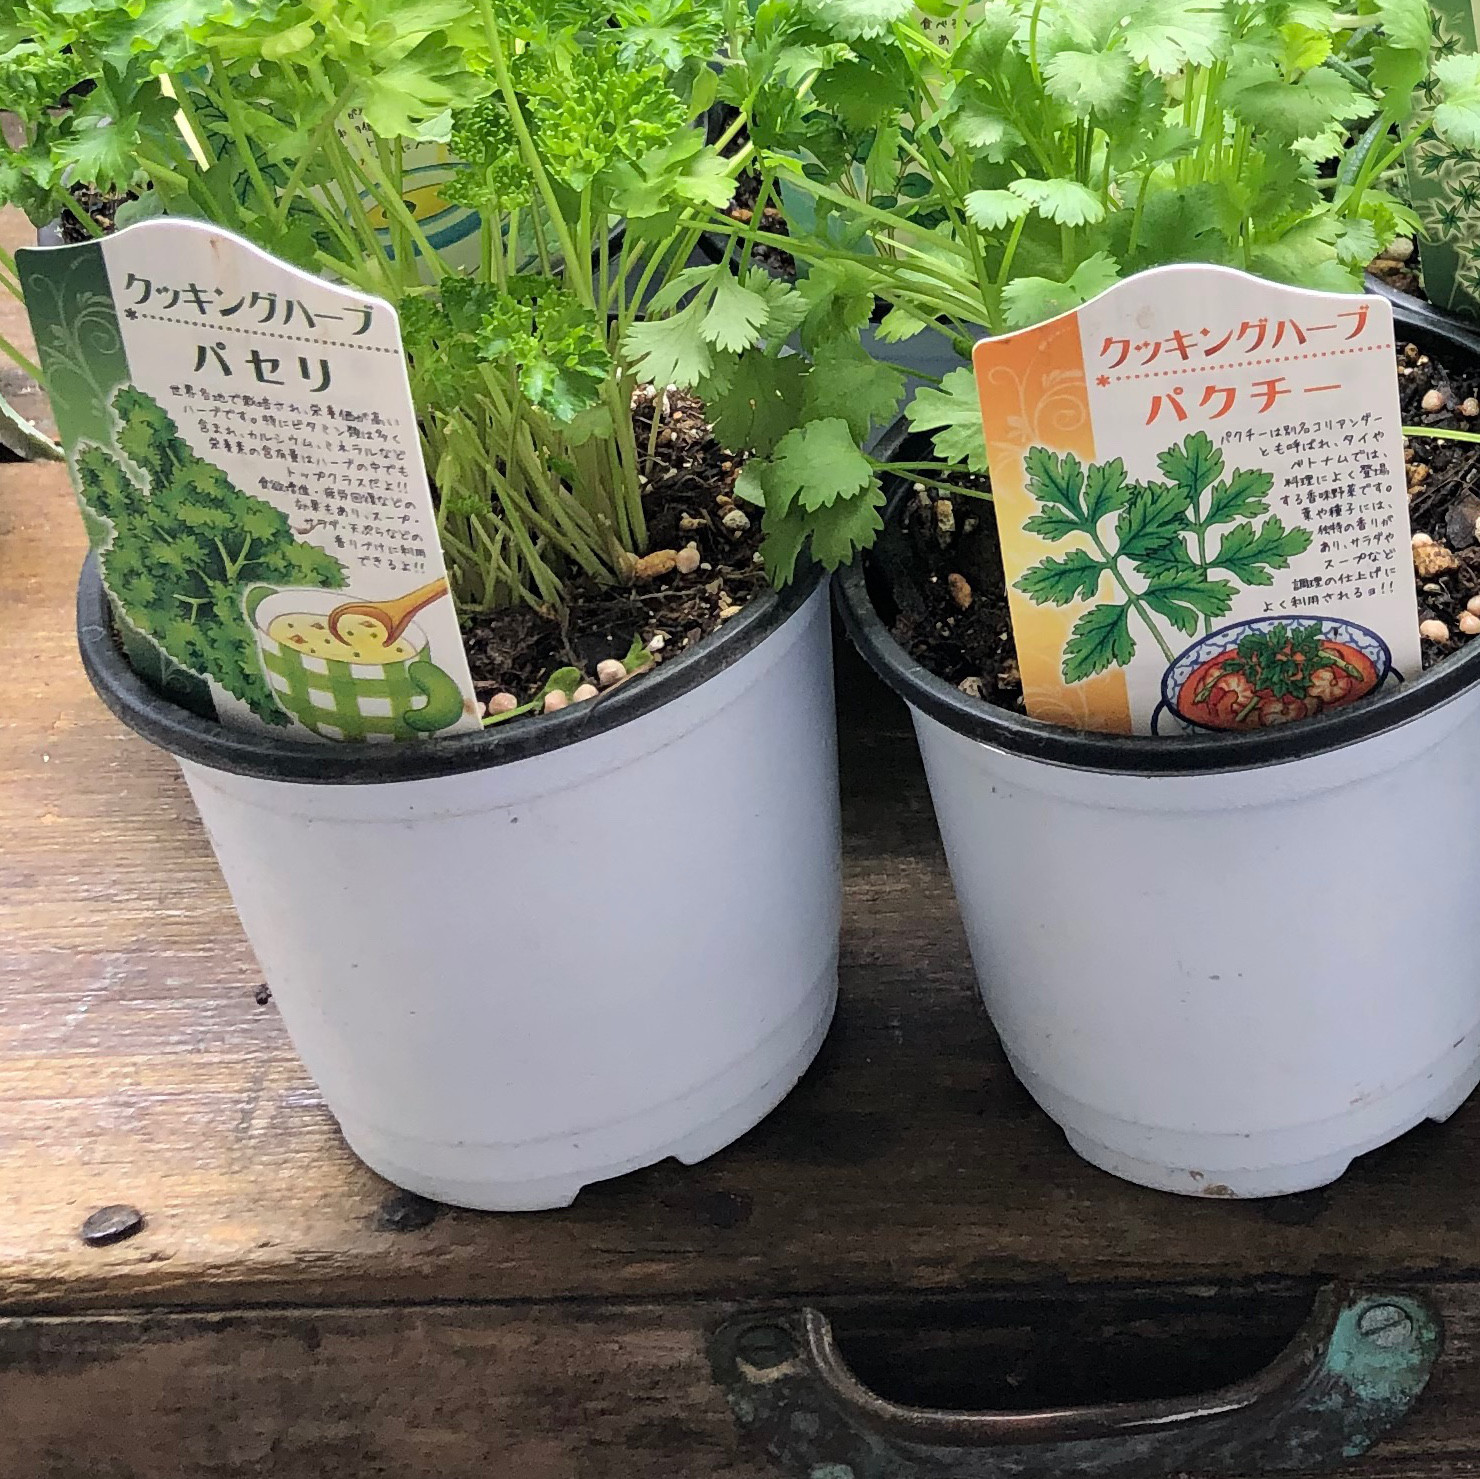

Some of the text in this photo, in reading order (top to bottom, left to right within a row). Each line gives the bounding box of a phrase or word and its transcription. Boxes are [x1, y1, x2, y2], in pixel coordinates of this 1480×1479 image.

[123, 271, 374, 338] クッキングハーブ
[1099, 304, 1372, 369] クッキングハーブ
[193, 341, 333, 393] パセリ
[1145, 376, 1342, 427] パクチー
[1324, 547, 1397, 570] スープなど
